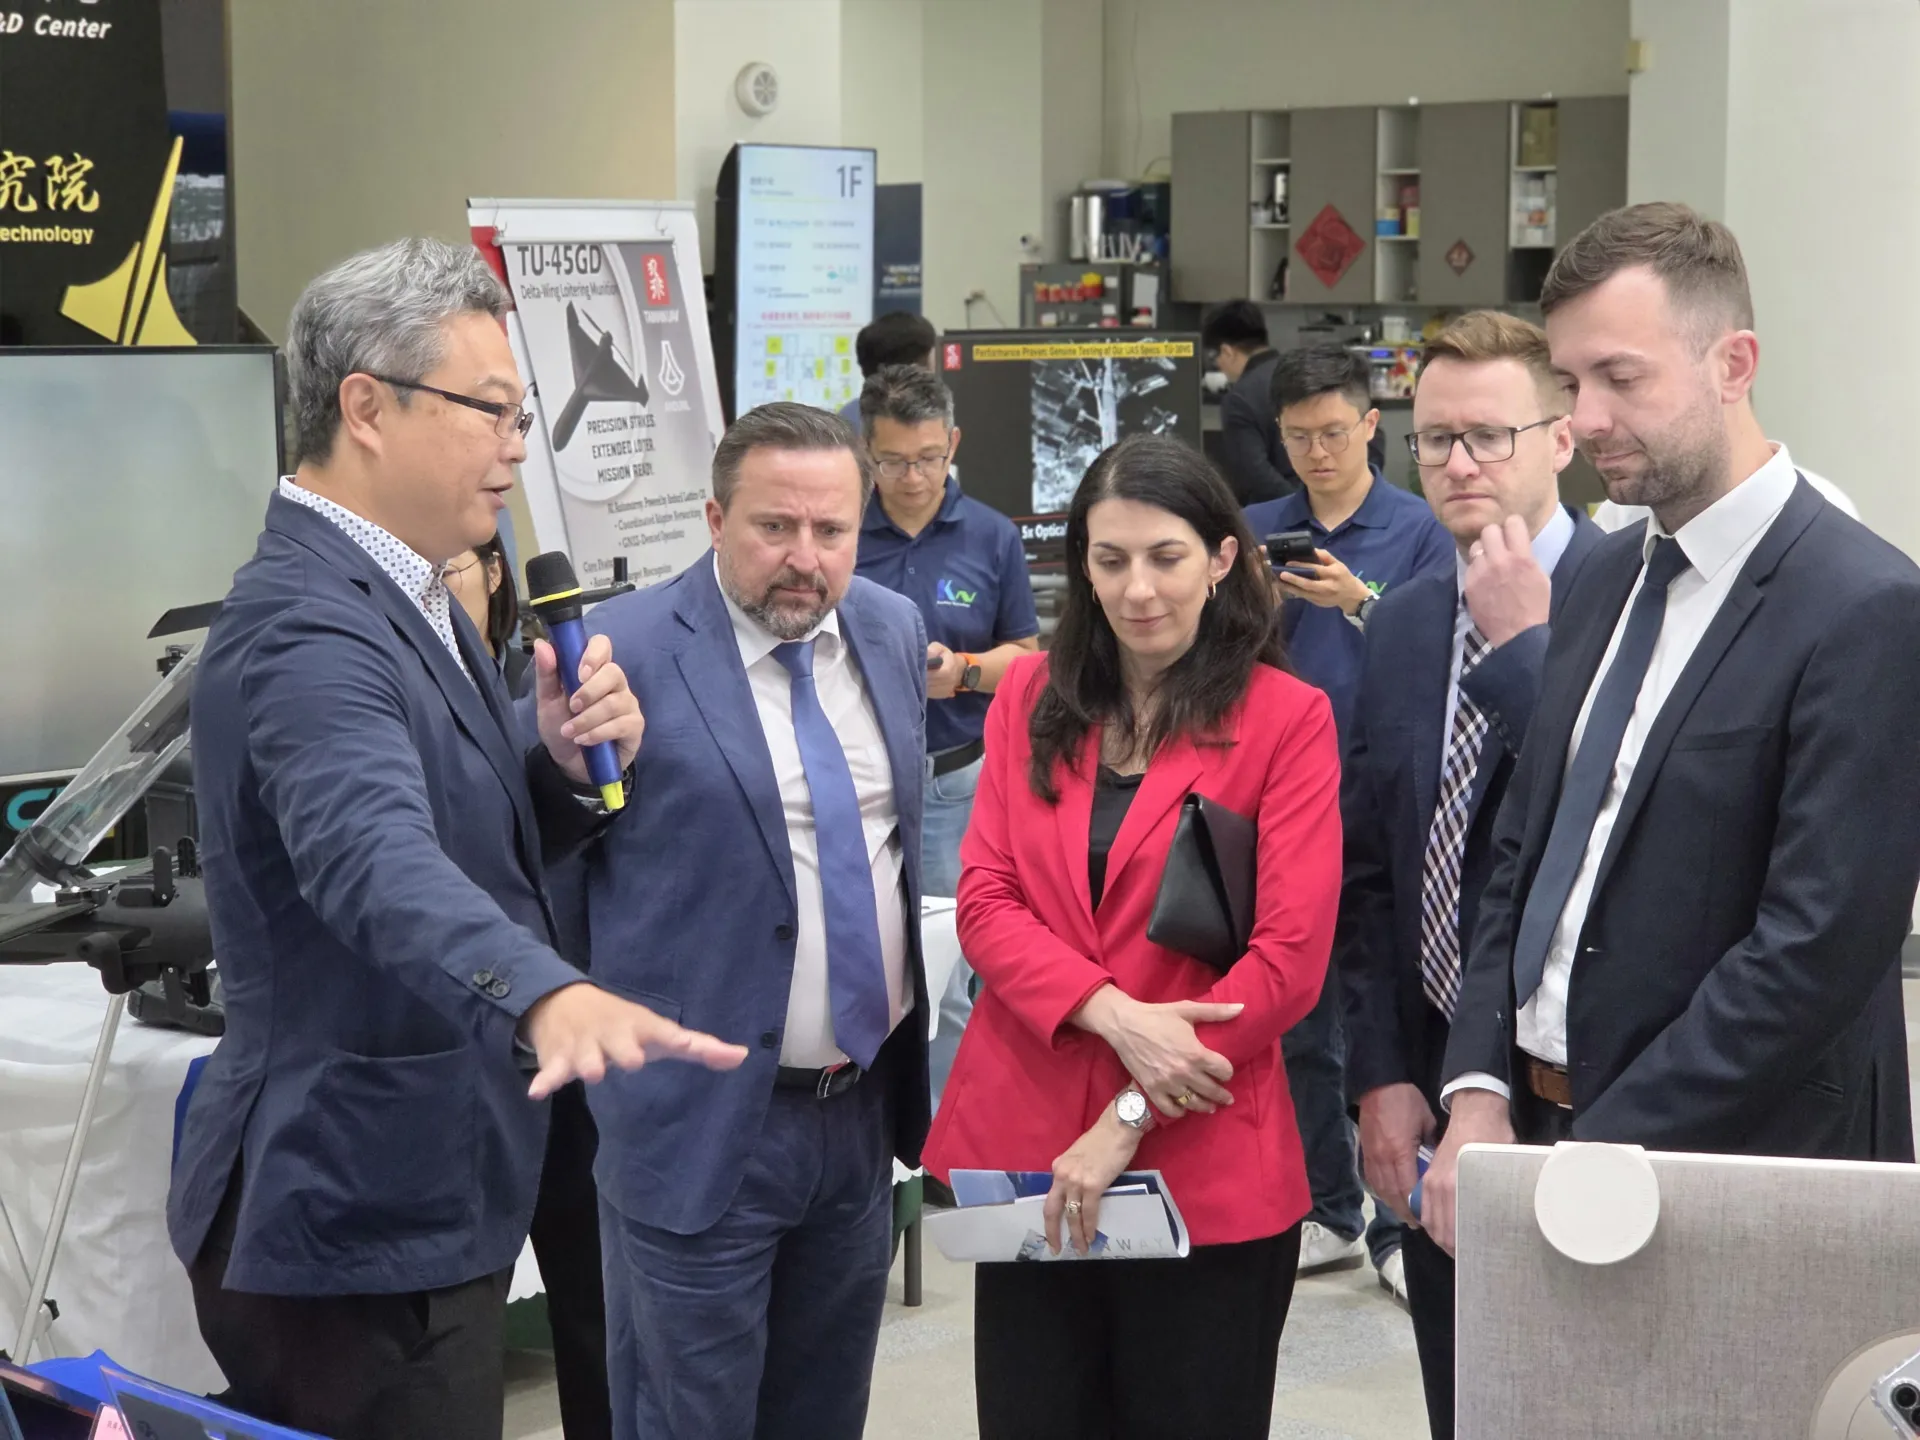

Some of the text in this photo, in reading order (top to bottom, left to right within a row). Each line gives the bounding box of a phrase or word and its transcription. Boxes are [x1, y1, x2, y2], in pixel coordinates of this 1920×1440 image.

[34, 14, 113, 39] Center
[0, 150, 100, 212] 究院
[836, 165, 864, 199] 1F
[517, 244, 603, 276] TU-45GD
[587, 417, 628, 435] PRECISION
[592, 440, 633, 460] EXTENDED
[597, 465, 632, 483] MISSION
